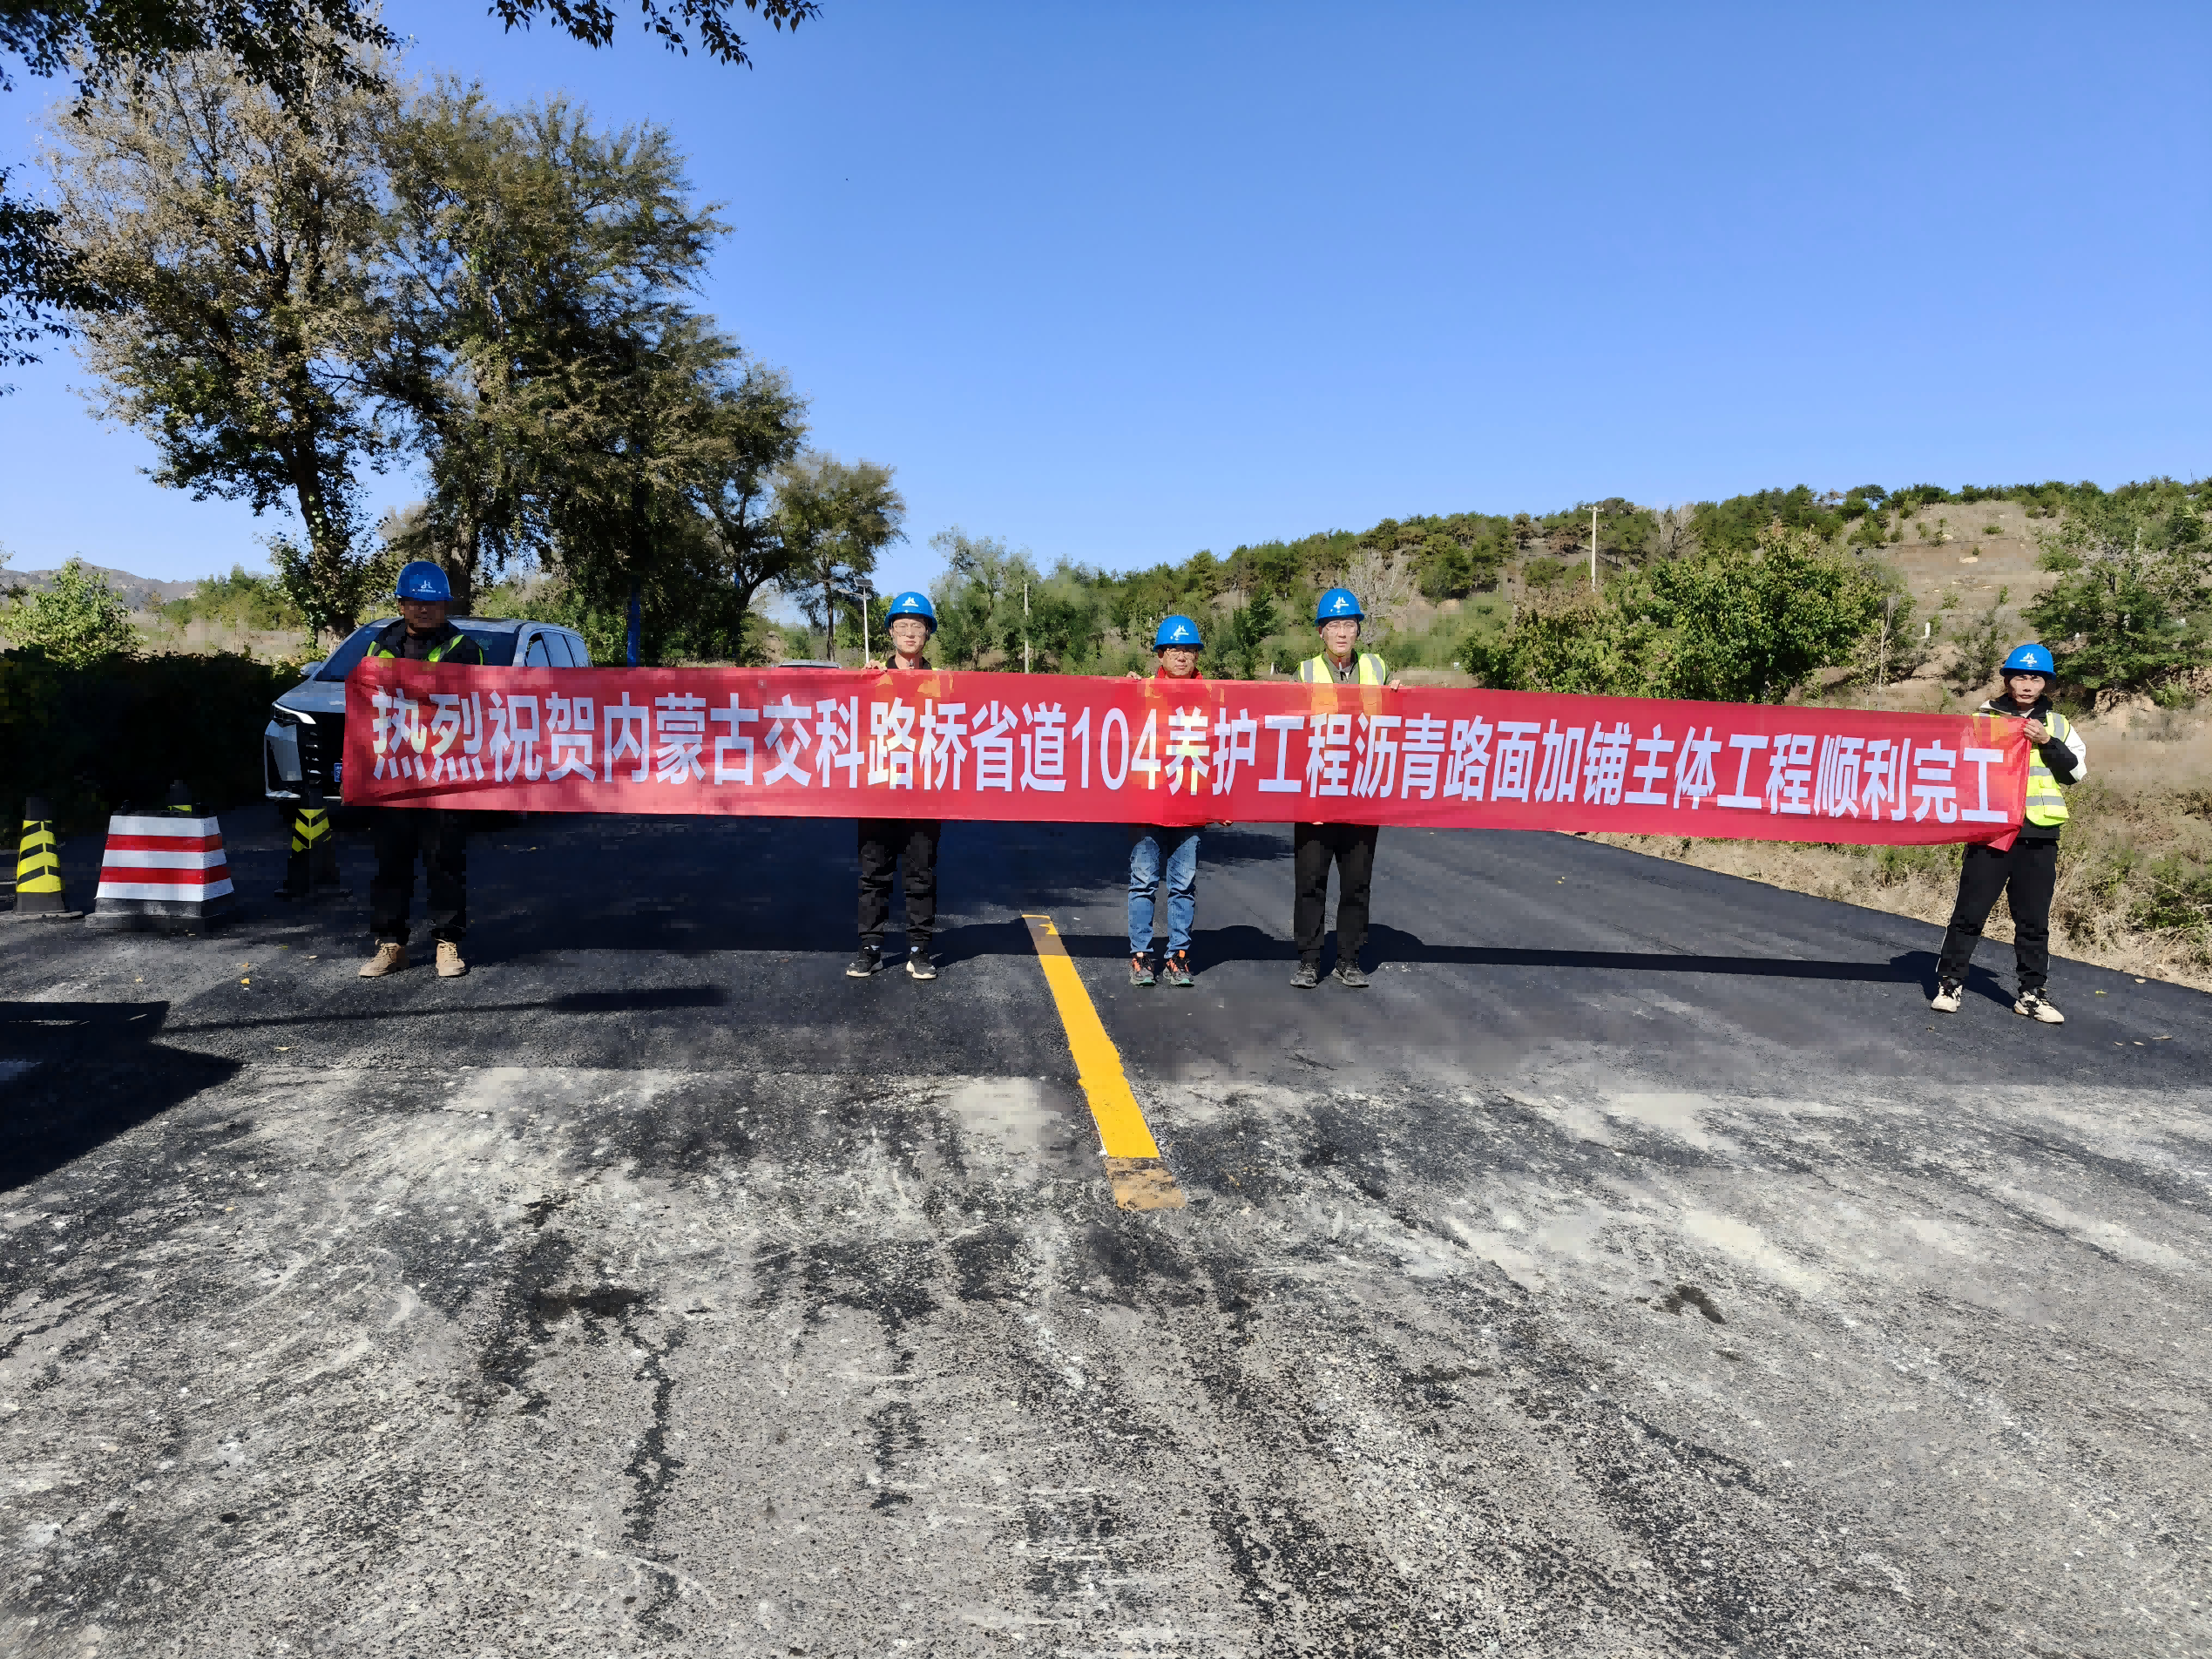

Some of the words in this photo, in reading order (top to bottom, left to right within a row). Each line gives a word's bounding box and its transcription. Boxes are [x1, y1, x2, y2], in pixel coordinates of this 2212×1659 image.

[371, 685, 2009, 824] 热烈祝贺内蒙古交科路桥省道104养护工程沥青路面加铺主体工程顺利完工
